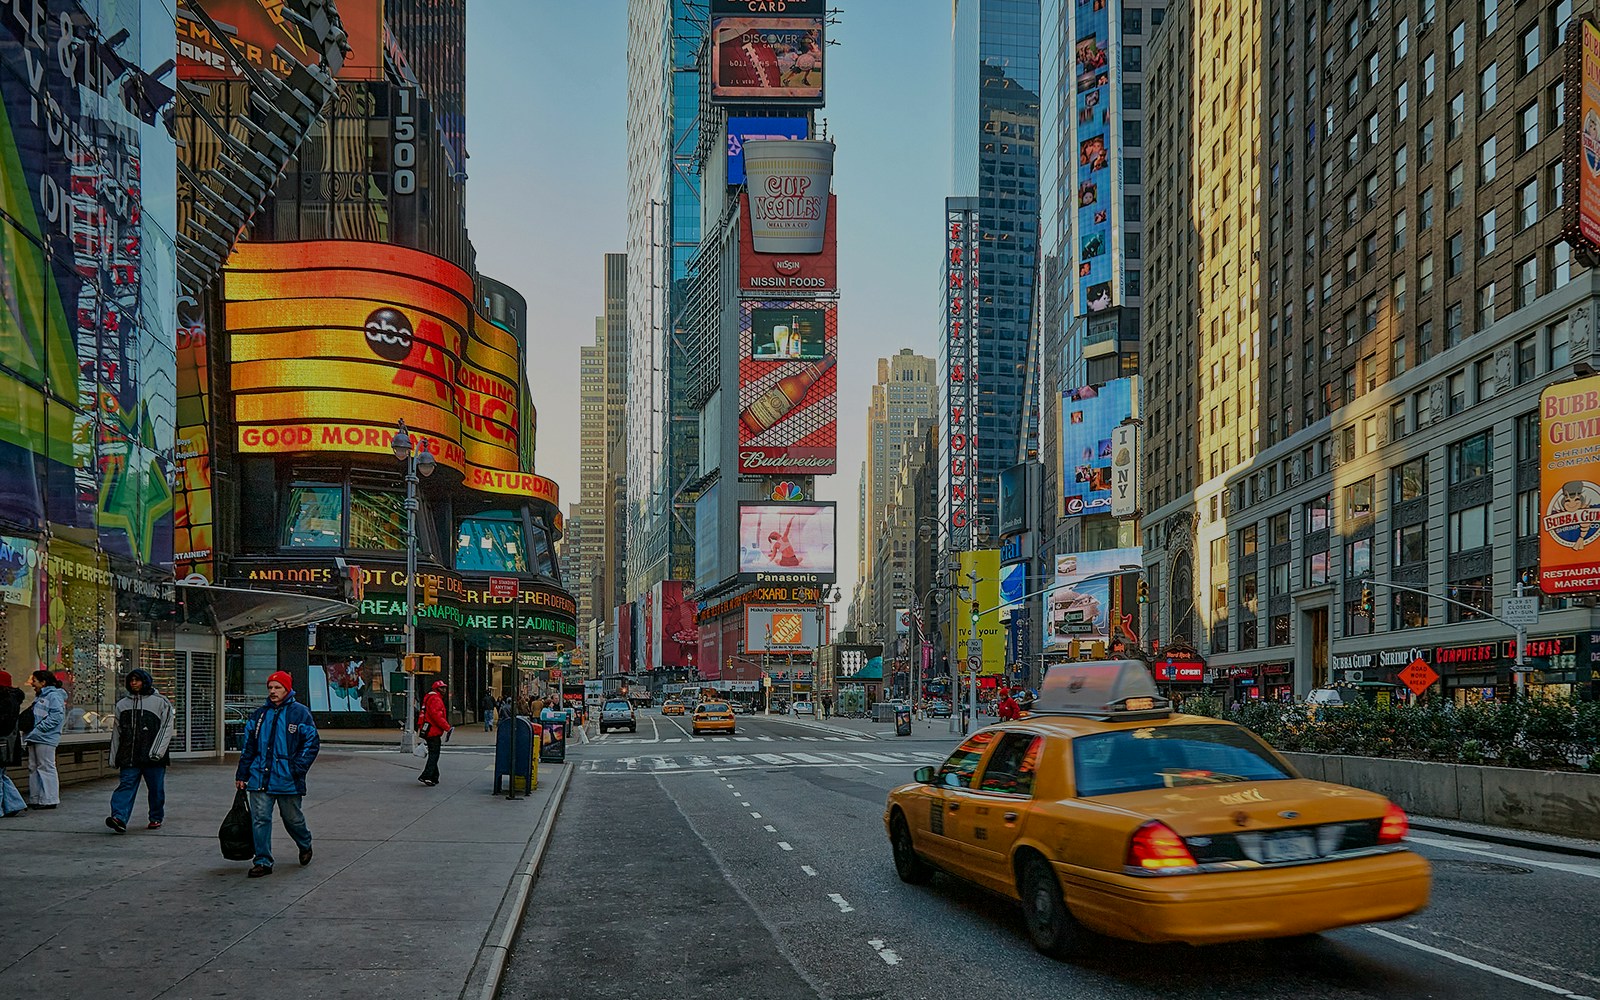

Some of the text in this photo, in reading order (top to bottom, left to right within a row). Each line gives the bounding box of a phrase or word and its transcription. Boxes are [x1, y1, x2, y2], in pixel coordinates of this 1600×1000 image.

[748, 2, 787, 12] CARD
[176, 17, 262, 65] EMER
[742, 34, 798, 44] DISCOVER
[393, 89, 416, 195] 1500
[764, 176, 811, 197] CUP
[754, 197, 822, 220] NOODLES
[777, 260, 800, 270] NISSIN
[751, 277, 826, 288] NISSIN FOODS
[951, 223, 963, 338] ERNST
[365, 321, 412, 347] abc
[951, 363, 964, 383] &
[1545, 391, 1600, 419] BUBB
[242, 426, 312, 448] GOOD
[322, 426, 441, 458] MORNNG
[1119, 429, 1127, 445] I
[739, 452, 834, 468] Budweiser
[951, 406, 967, 528] YOUNG
[473, 468, 555, 496] SATURDAY
[1546, 513, 1578, 529] BUBBA
[54, 556, 74, 576] THE
[75, 563, 114, 587] PERFECT
[116, 574, 132, 589] TOY
[757, 573, 818, 582] Panasonic
[1543, 564, 1600, 579] RESTAURA
[772, 614, 802, 643] HOME
[978, 629, 998, 638] your
[1436, 645, 1491, 663] COMPUTERS
[1508, 640, 1561, 658] CMERAS
[1332, 655, 1352, 670] BUBBA
[1352, 653, 1371, 668] GUMP
[1379, 650, 1408, 666] SHRIMP
